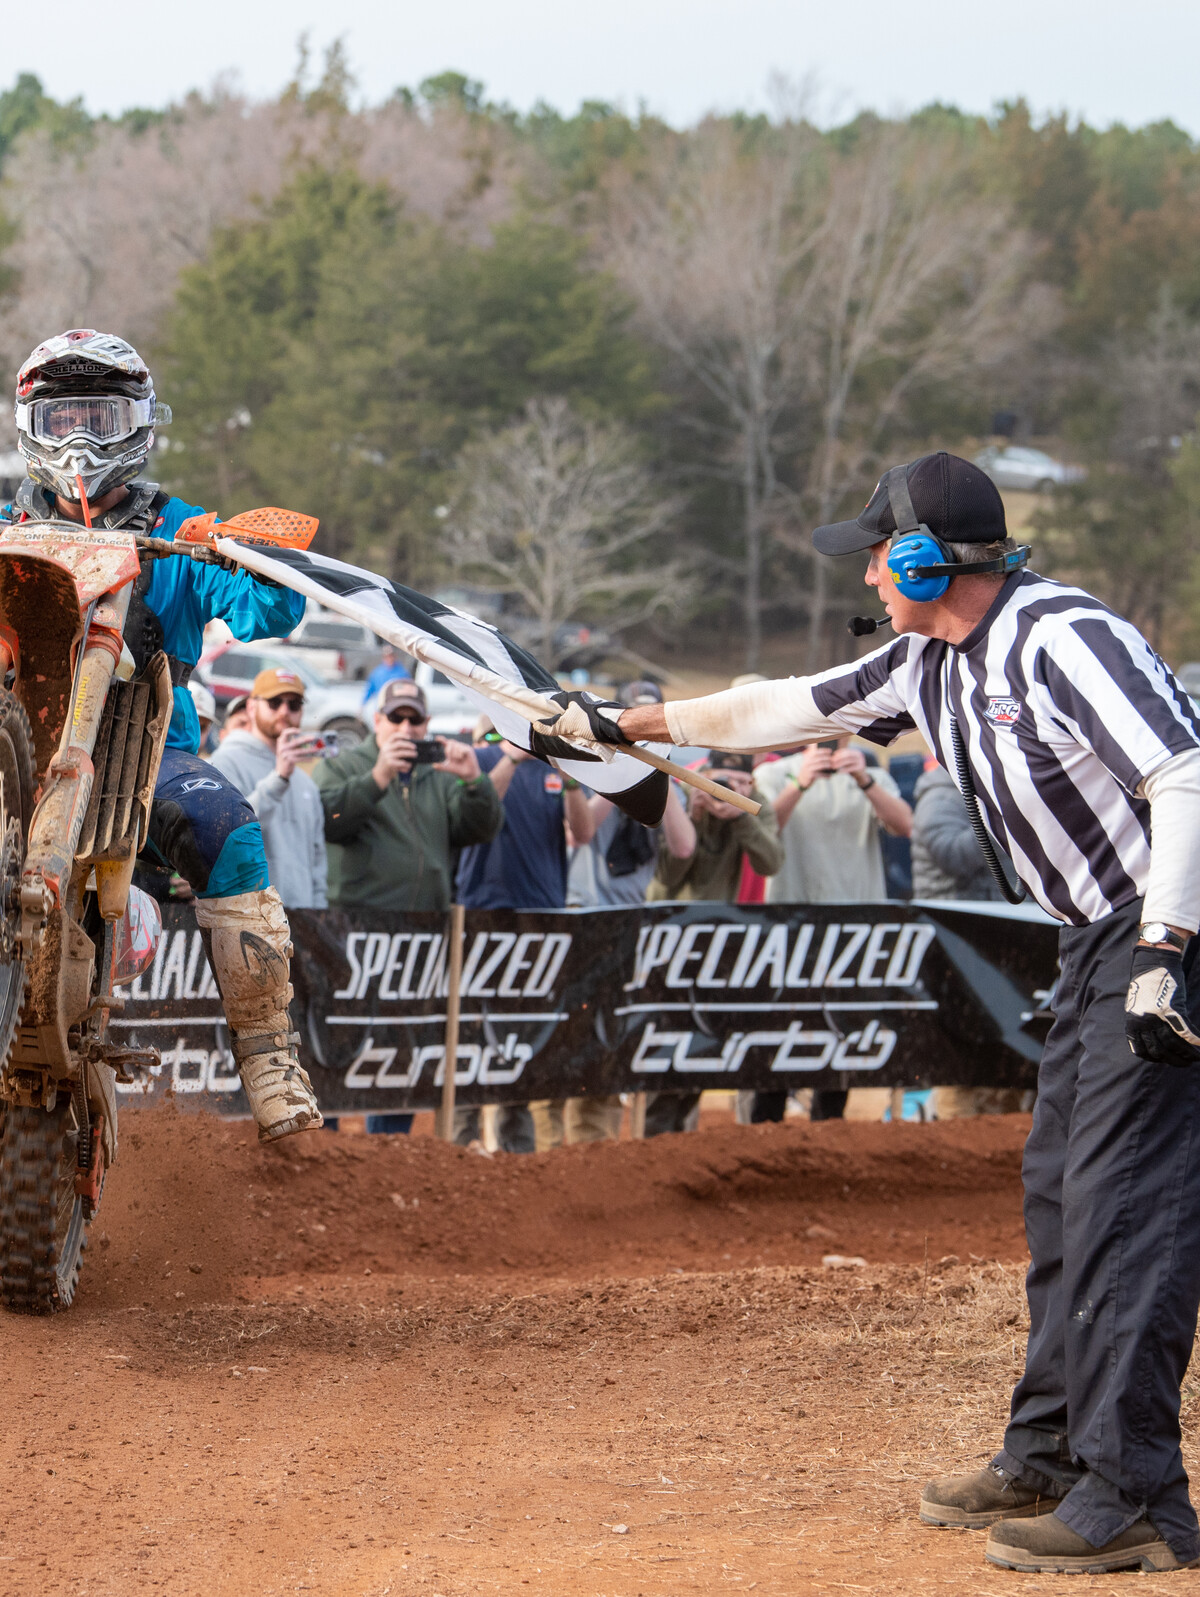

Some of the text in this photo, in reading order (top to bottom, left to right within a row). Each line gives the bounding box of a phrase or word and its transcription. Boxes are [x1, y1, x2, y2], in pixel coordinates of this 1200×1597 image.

[54, 364, 102, 373] HELLION
[333, 931, 573, 1000] SPECIAIZED
[623, 922, 937, 992] SPECIALIZED
[1156, 979, 1170, 1008] thor
[630, 1019, 898, 1073] turbo
